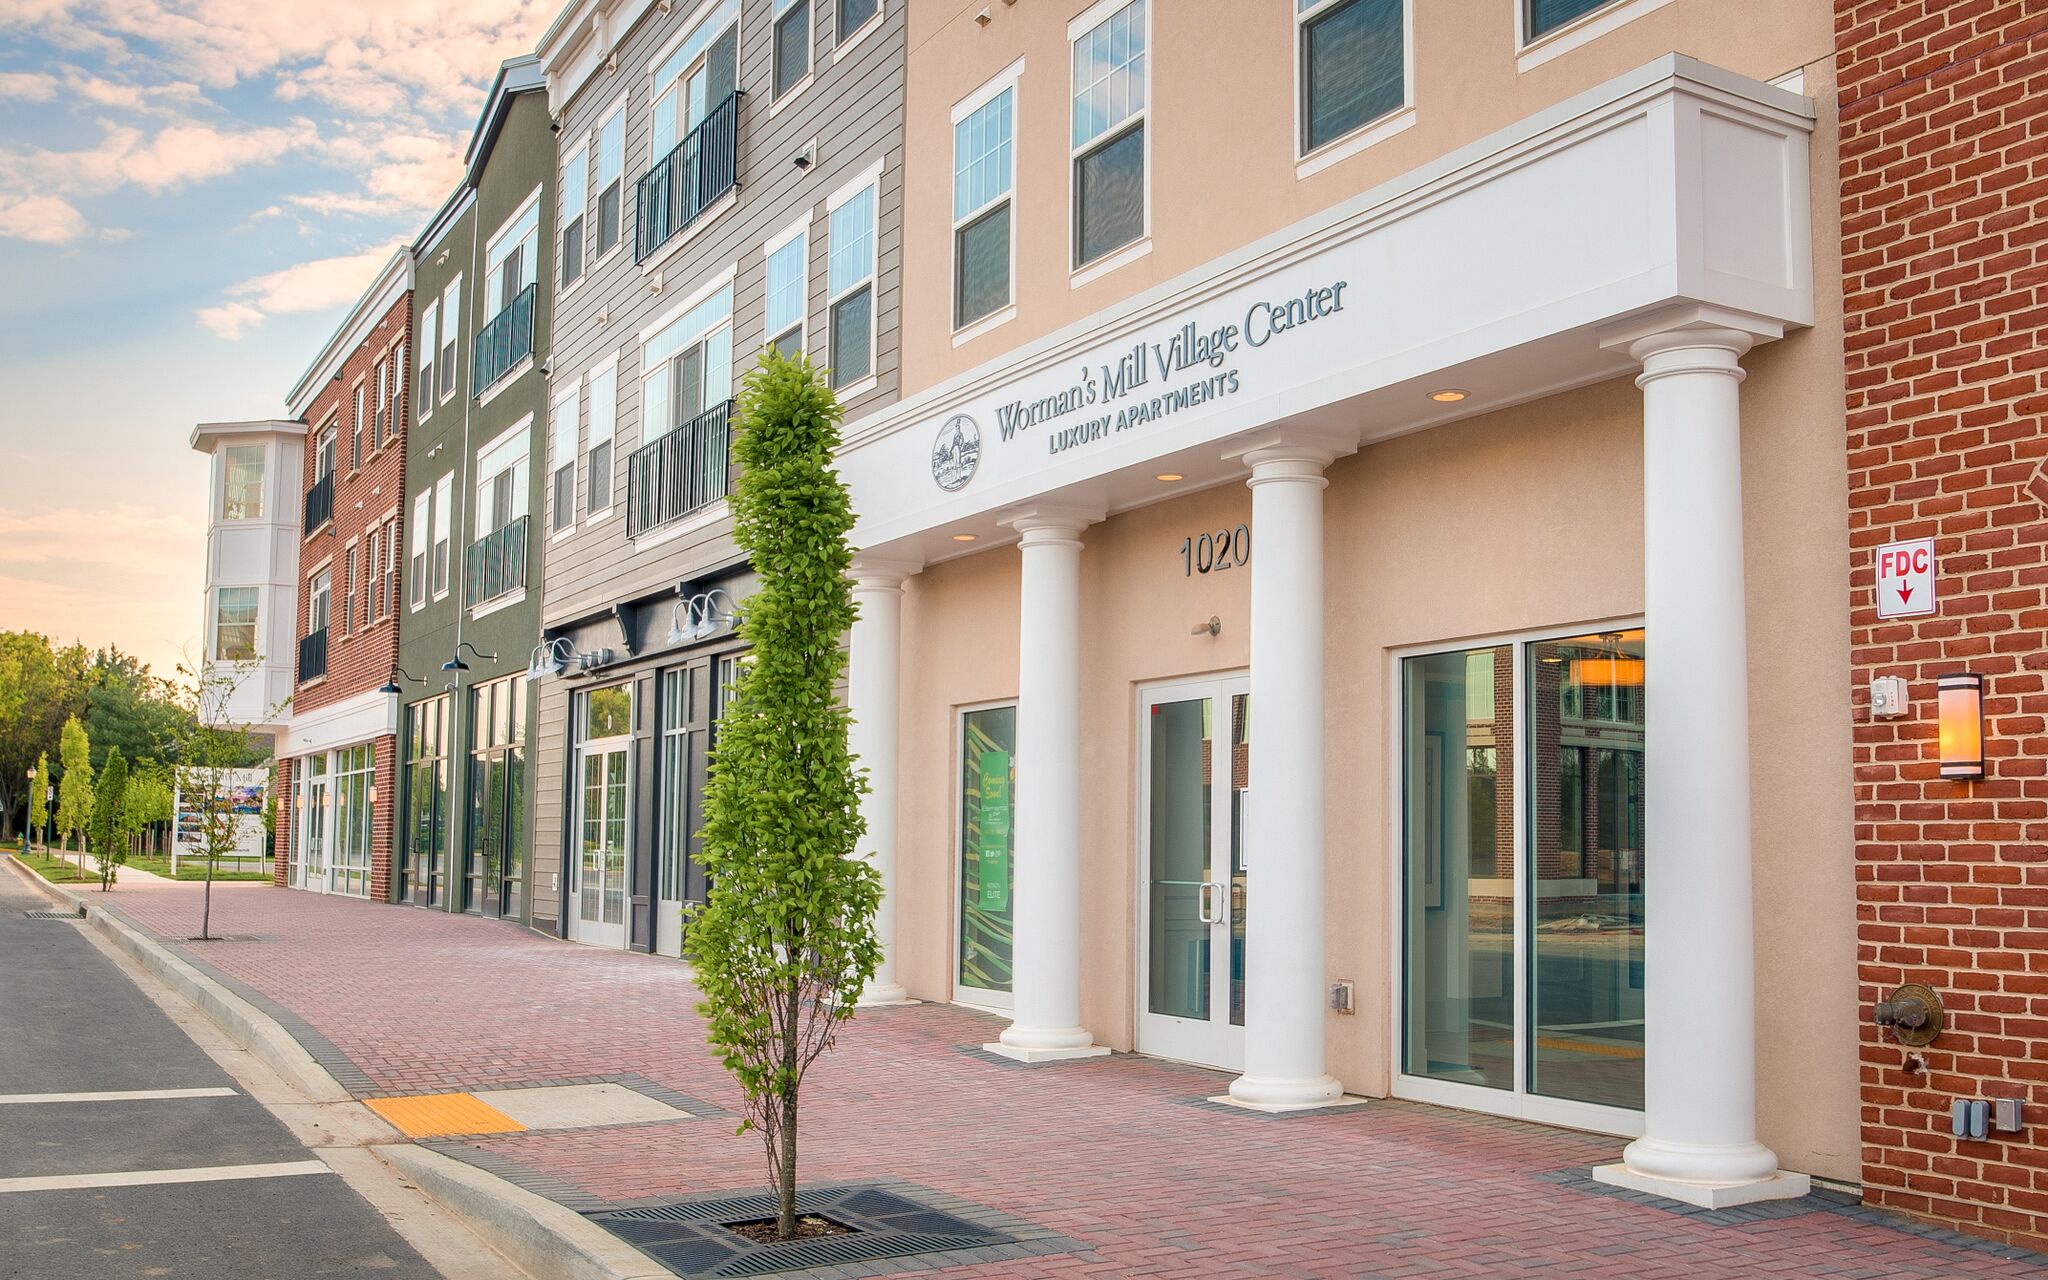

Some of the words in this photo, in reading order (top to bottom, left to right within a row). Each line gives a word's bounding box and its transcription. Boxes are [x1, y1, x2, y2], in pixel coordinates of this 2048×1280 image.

[994, 365, 1097, 443] Worman's
[1101, 341, 1148, 404] Mill
[1151, 321, 1239, 382] Village
[1244, 280, 1348, 348] Center
[1049, 414, 1112, 455] LUXURY
[1115, 369, 1240, 432] APARTMENTS
[1180, 523, 1250, 577] 1020
[1880, 547, 1929, 579] FDC
